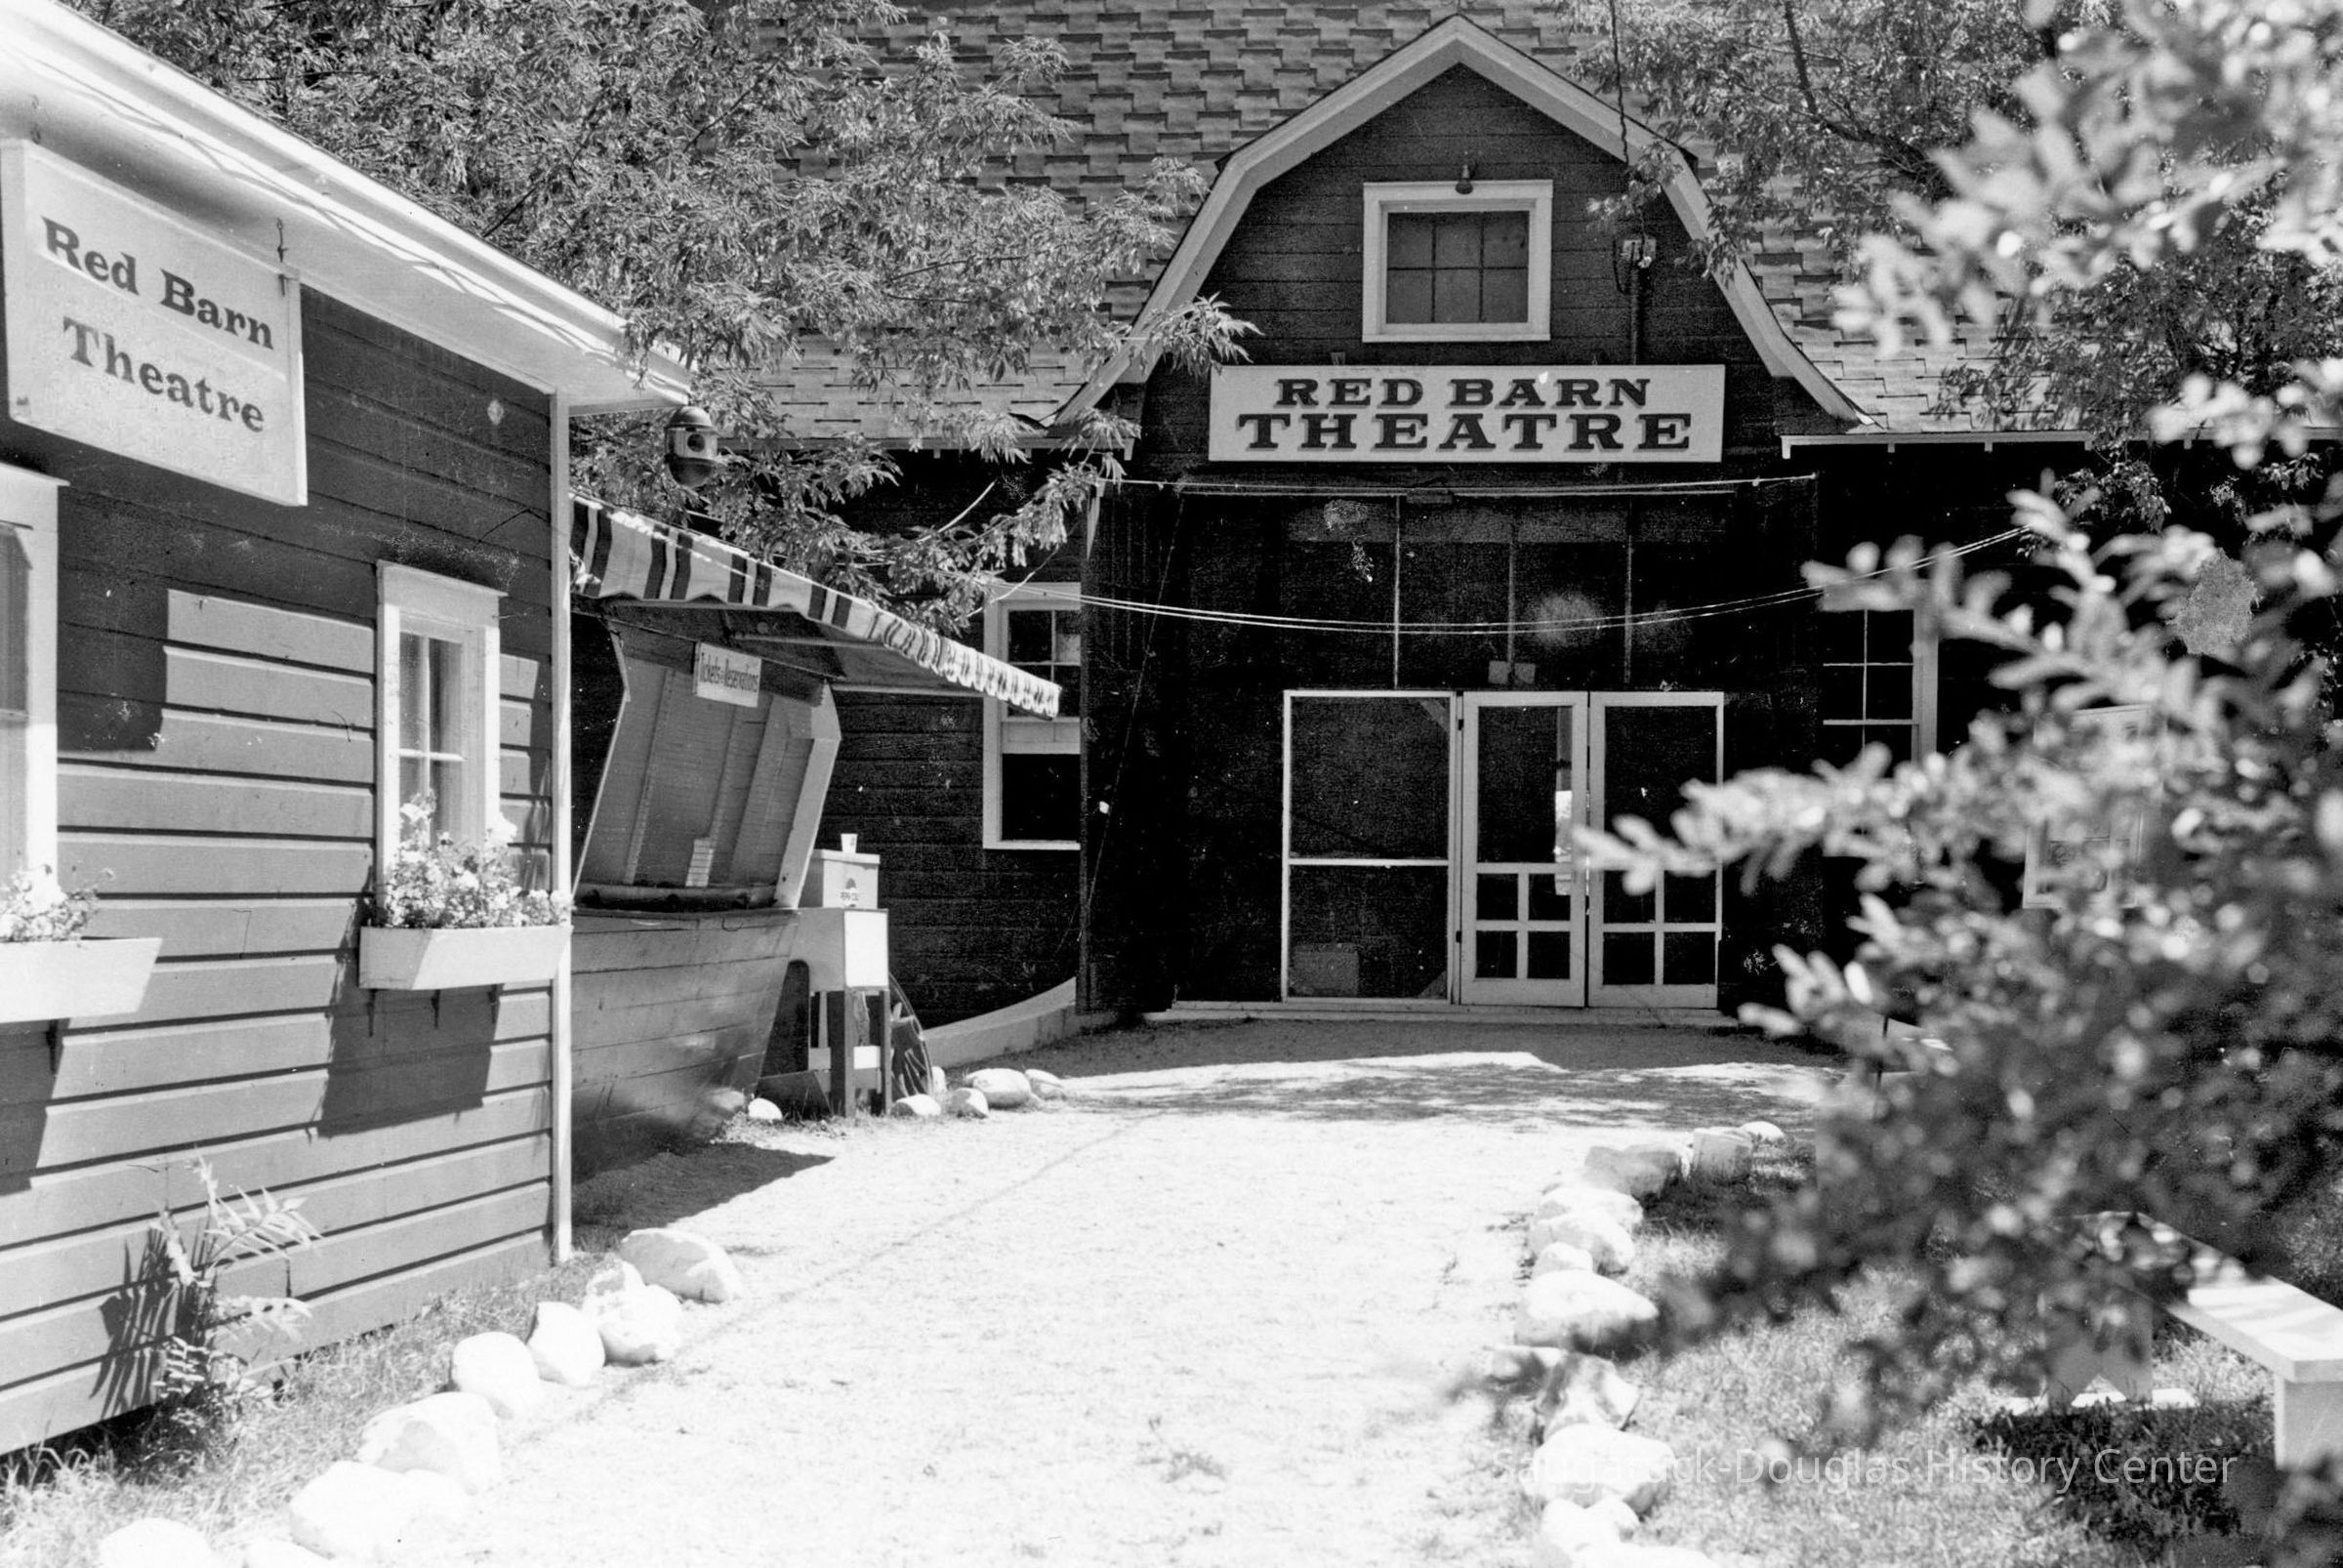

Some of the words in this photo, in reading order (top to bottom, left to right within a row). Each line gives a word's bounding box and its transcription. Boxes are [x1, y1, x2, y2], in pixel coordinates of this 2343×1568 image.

[41, 216, 140, 296] Red
[159, 268, 274, 351] Barn
[62, 315, 266, 433] Theatre
[1276, 377, 1424, 408] RED
[1445, 377, 1652, 408] BARN
[1235, 412, 1693, 454] THEATRE
